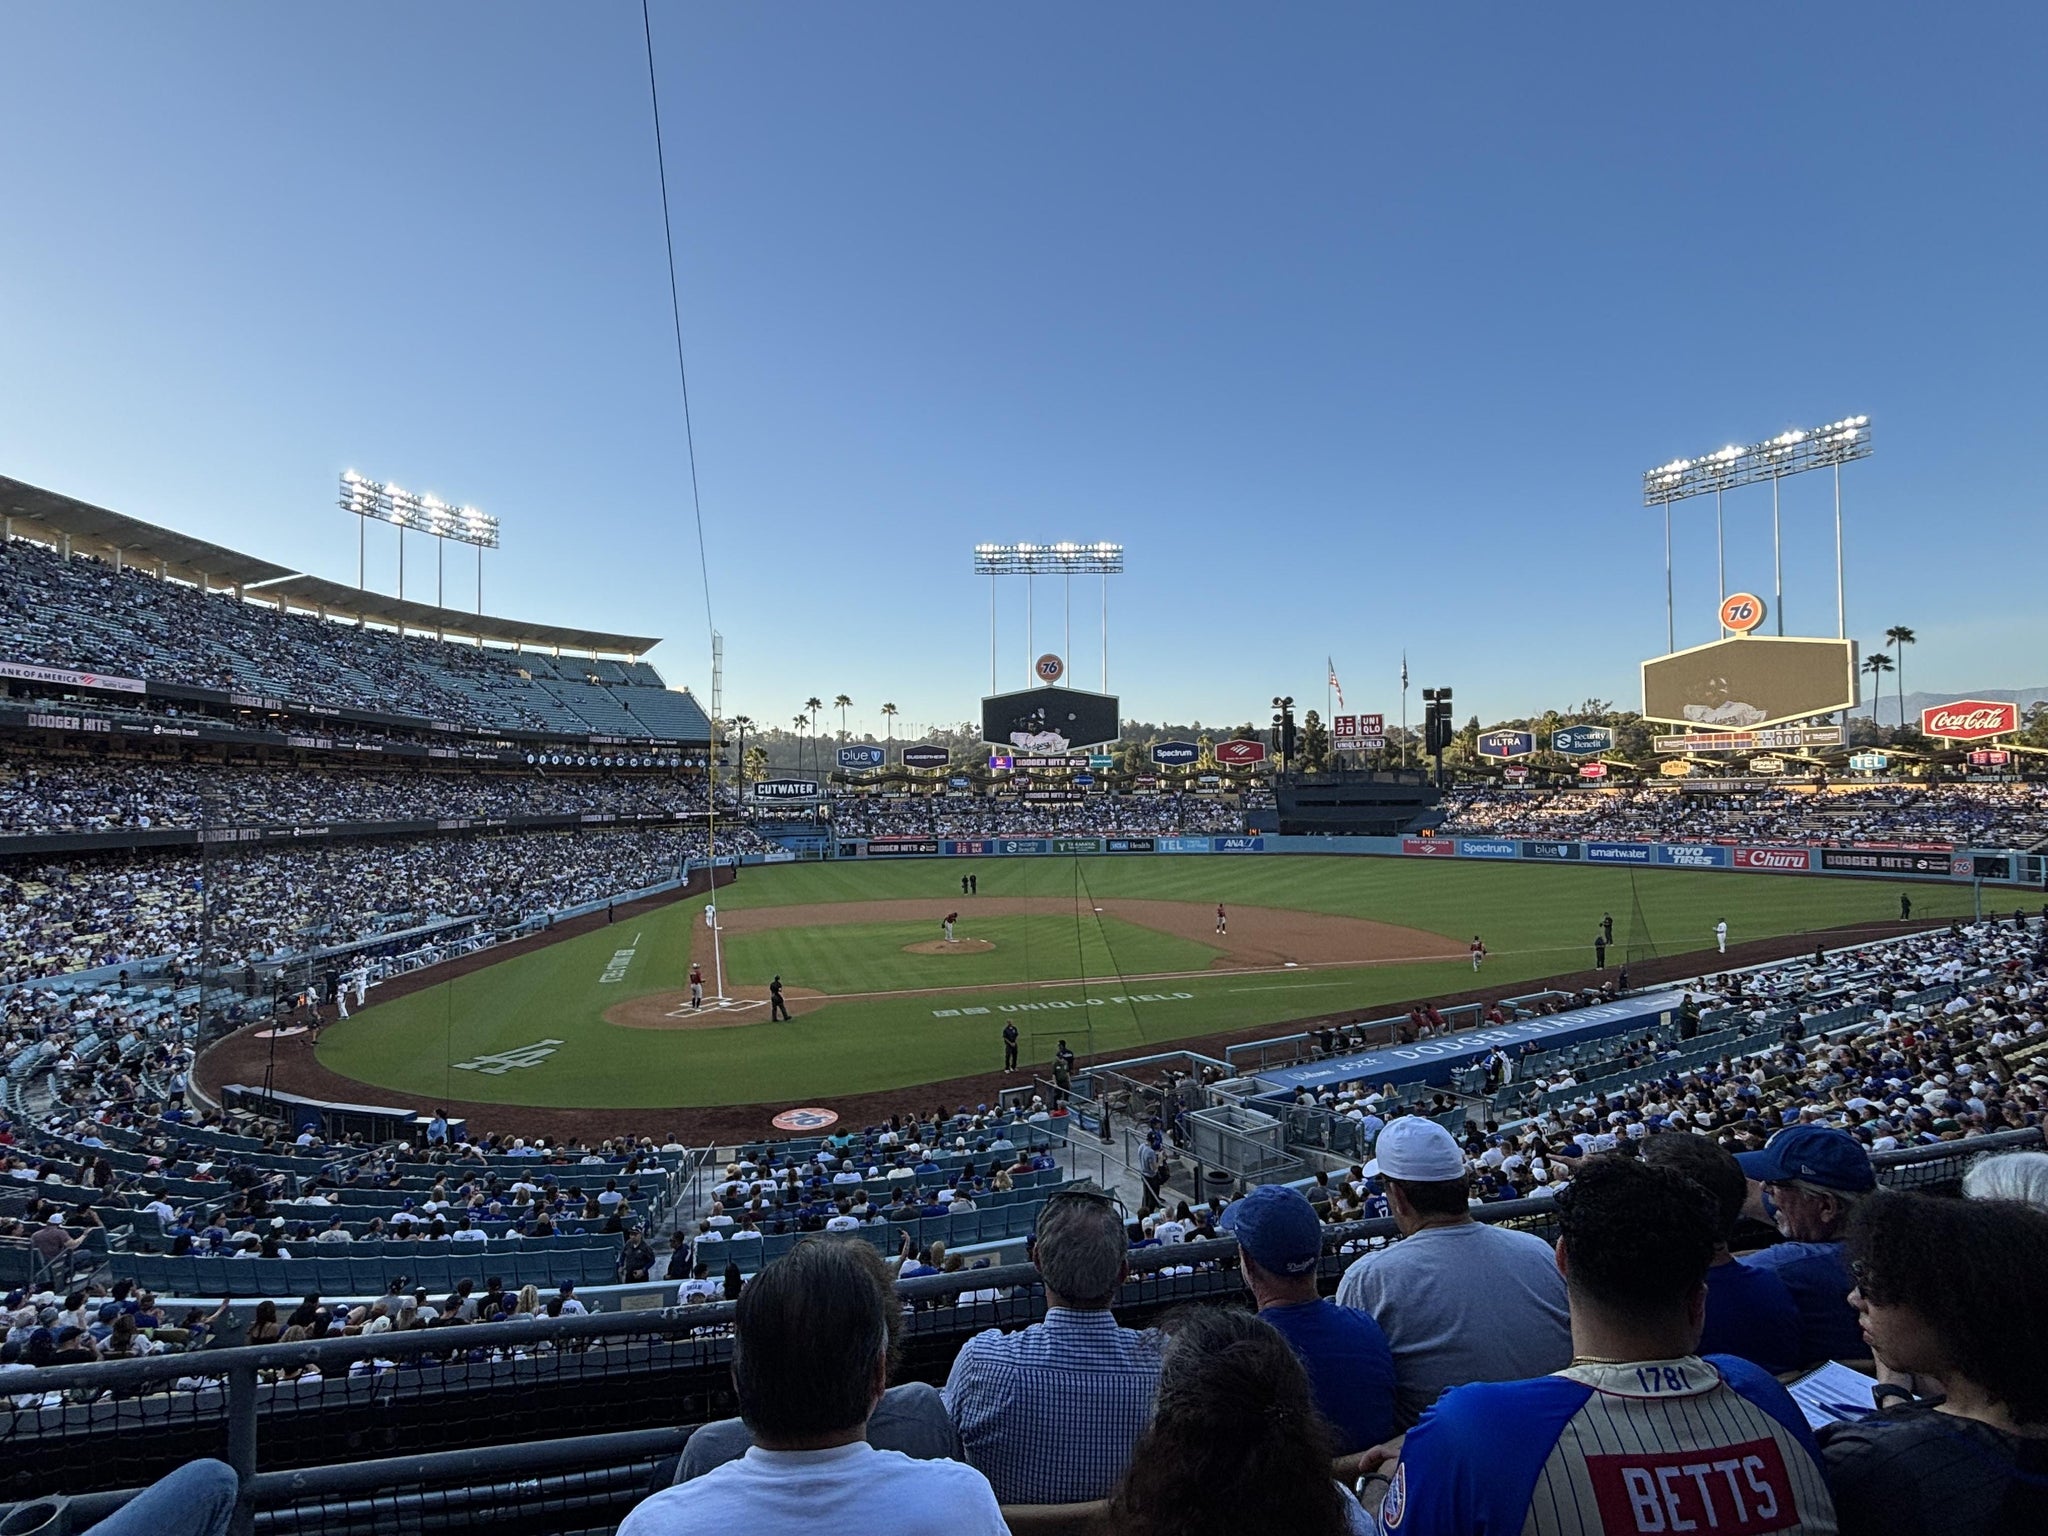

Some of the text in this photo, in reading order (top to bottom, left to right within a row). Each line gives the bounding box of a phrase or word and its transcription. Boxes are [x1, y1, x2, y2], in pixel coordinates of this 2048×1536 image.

[1728, 602, 1753, 621] 76
[1043, 661, 1058, 674] 76
[0, 667, 78, 684] ANK OF AMERICA
[230, 694, 262, 708] DODGER
[264, 698, 282, 710] HITS
[27, 713, 111, 732] DODGER HITS
[1362, 717, 1379, 725] UNI
[1930, 707, 2006, 731] Coca-Cola
[1363, 725, 1381, 734] QLO
[1489, 738, 1521, 746] ULTRA
[1573, 732, 1606, 741] Security
[287, 737, 315, 748] DODGER
[317, 739, 332, 749] HITS
[1337, 740, 1382, 749] UNIQLO FIELD
[1574, 740, 1602, 748] Benefit
[841, 750, 868, 760] blue
[1157, 749, 1193, 758] Spectrum
[1048, 758, 1066, 766] HITS
[1855, 757, 1882, 767] TEL
[757, 783, 814, 796] CUTWATER
[198, 829, 237, 842] DODGER
[239, 828, 261, 841] HITS
[1422, 829, 1435, 838] 141
[1129, 841, 1150, 849] Health
[1161, 840, 1183, 850] TEL
[1224, 839, 1245, 848] ANA
[1463, 843, 1509, 853] Spectrum
[1535, 845, 1557, 855] blue
[1590, 848, 1646, 859] smartwater
[1667, 847, 1704, 856] TOYO
[1673, 855, 1714, 865] TIRES
[1750, 850, 1805, 868] Churu
[1826, 855, 1913, 869] DODGER HITS
[1954, 861, 1971, 872] 76
[997, 998, 1105, 1013] UNIQLO
[1110, 992, 1195, 1004] FIELD
[1391, 1006, 1631, 1060] DODGER STADIUM
[782, 1111, 836, 1128] 76
[1378, 1206, 1388, 1218] 17
[1637, 1366, 1690, 1393] 1781
[1621, 1455, 1778, 1533] BETTS
